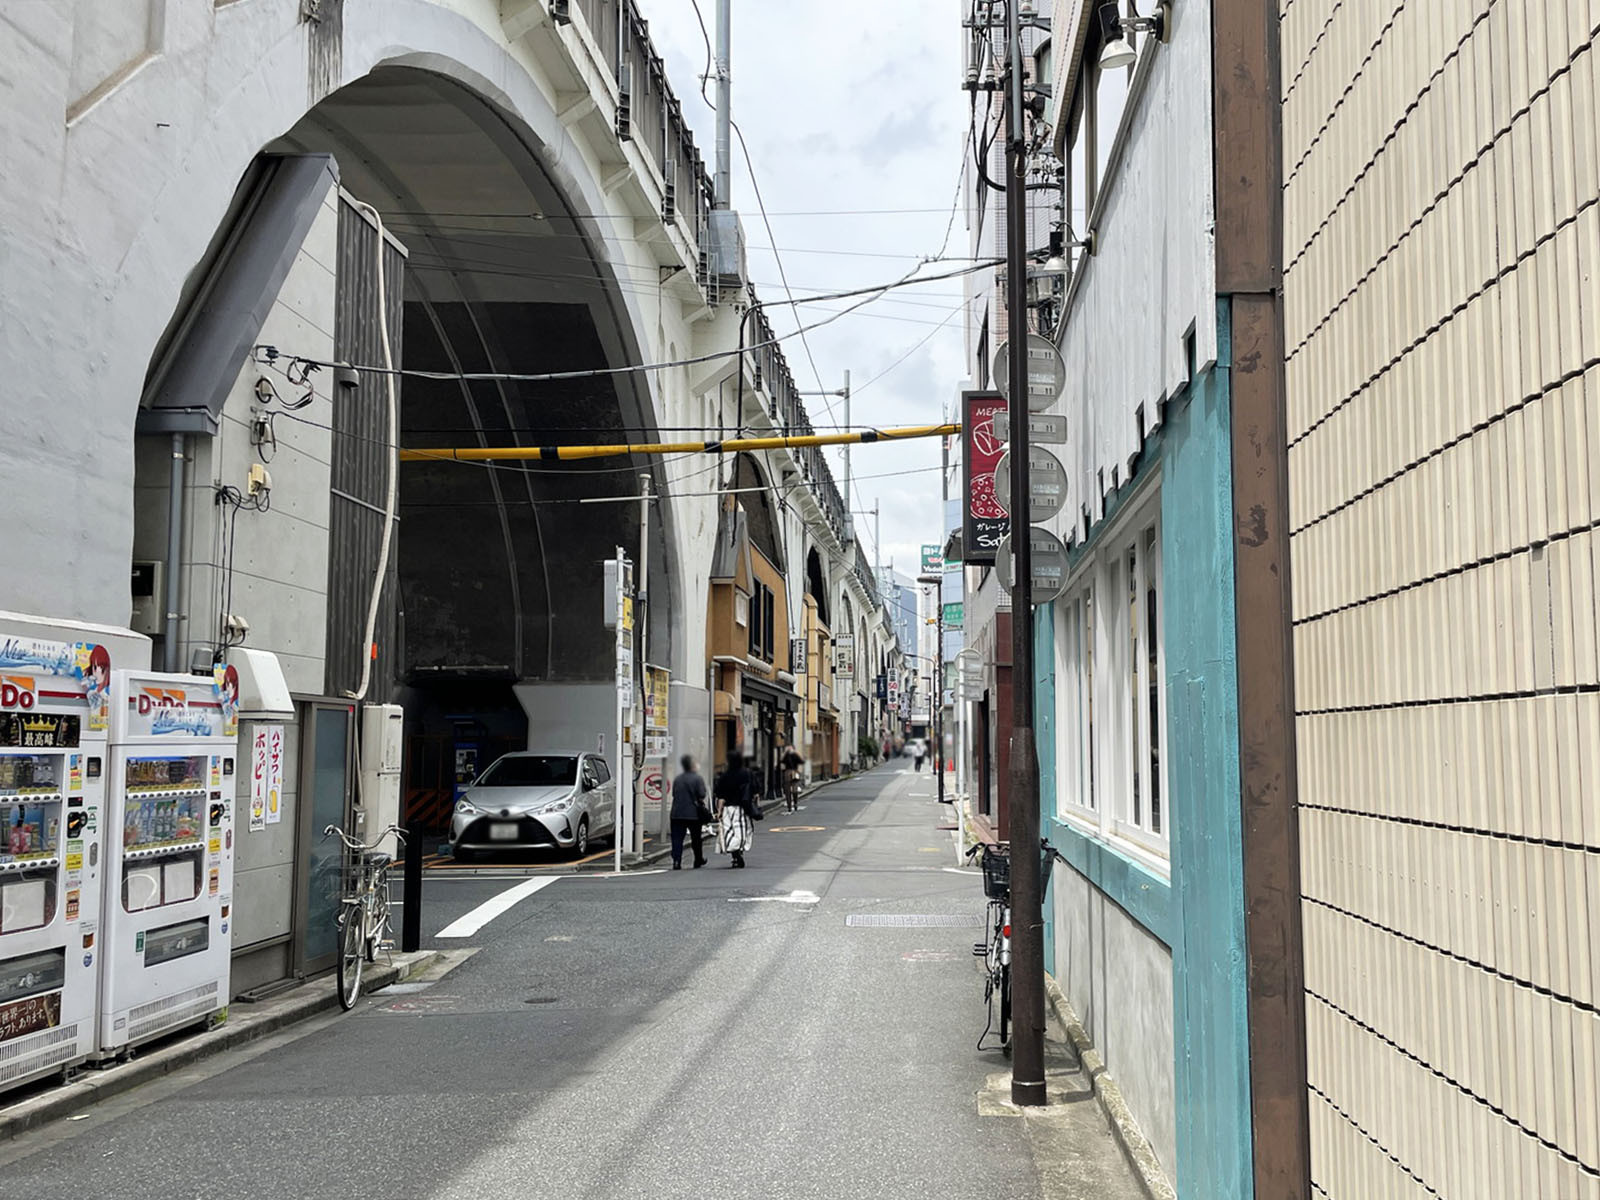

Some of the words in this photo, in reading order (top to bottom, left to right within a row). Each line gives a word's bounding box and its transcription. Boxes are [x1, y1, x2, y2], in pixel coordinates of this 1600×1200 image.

[976, 532, 1004, 547] Sat
[24, 732, 54, 747] 最高峰
[255, 732, 266, 797] ホッピー
[271, 730, 281, 785] ハイサワー
